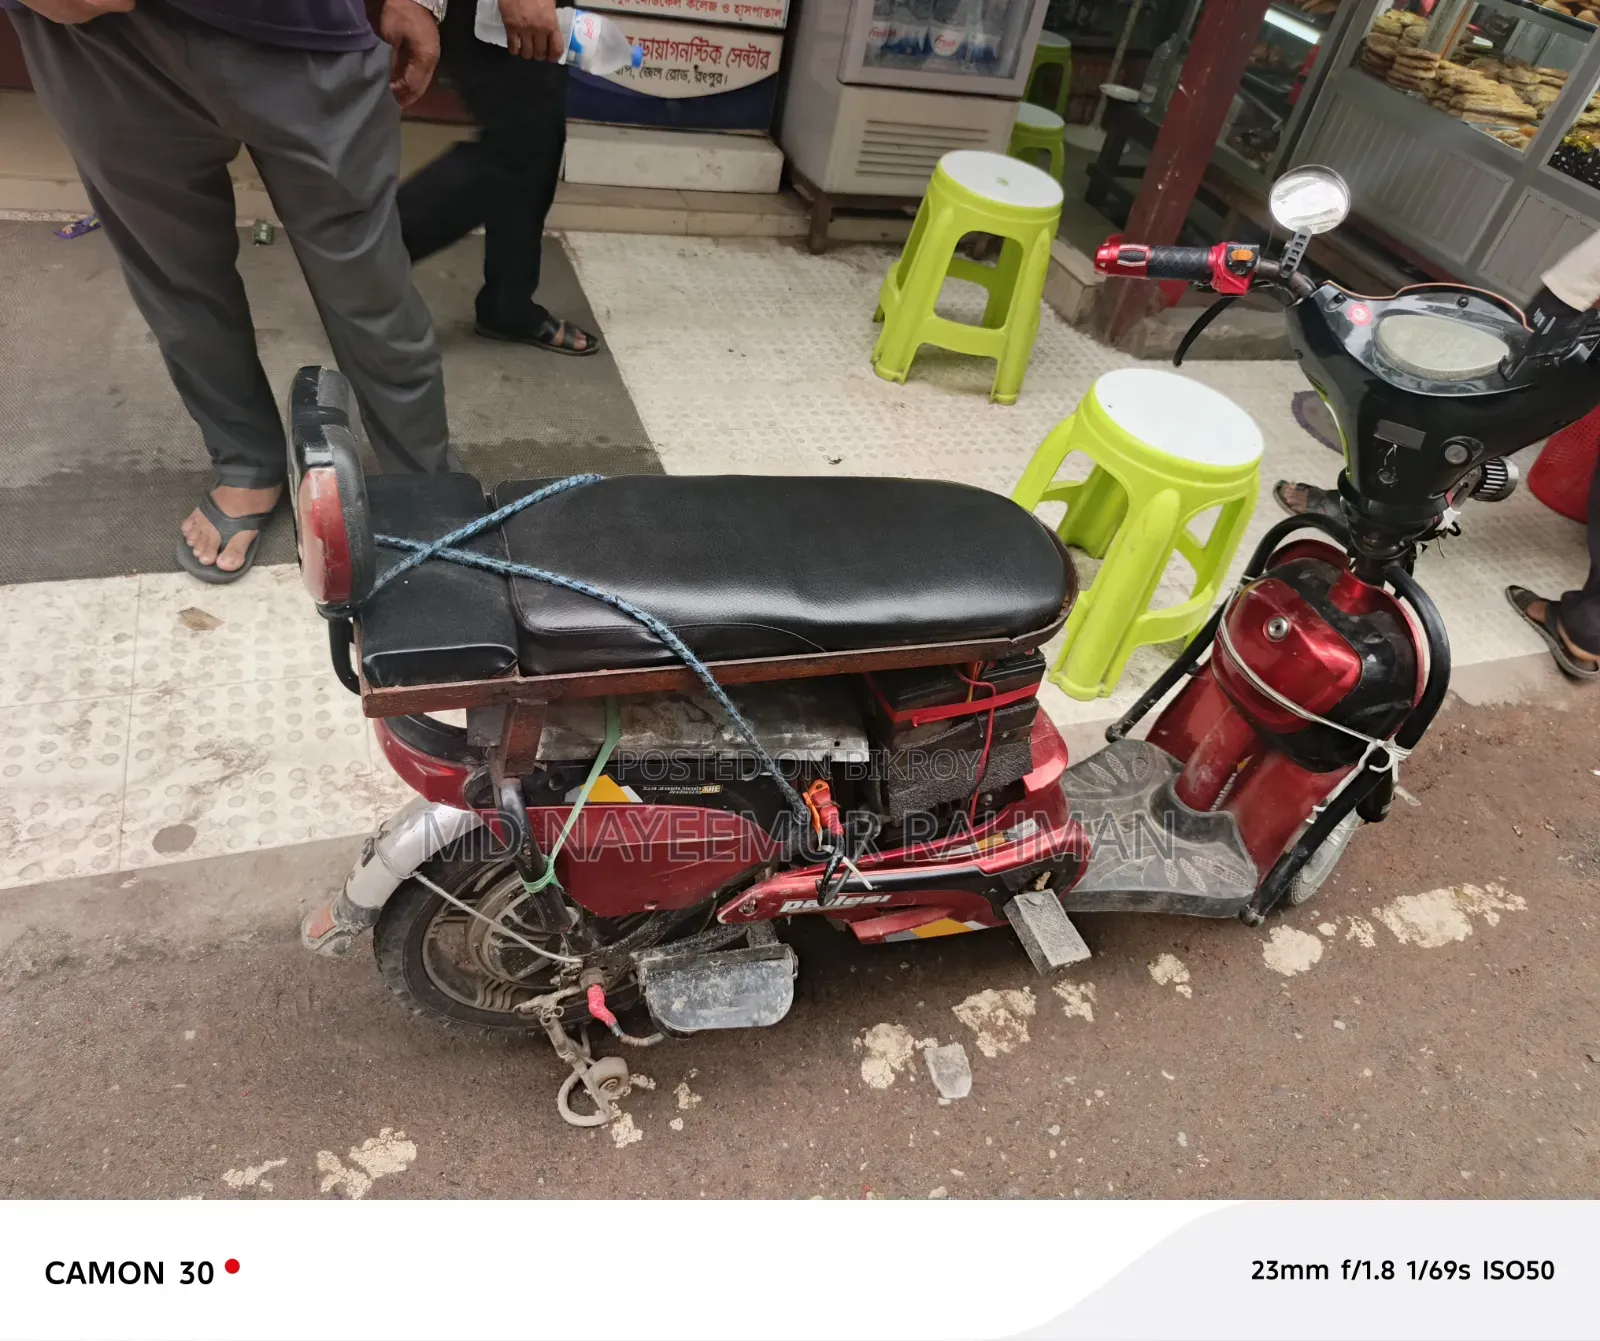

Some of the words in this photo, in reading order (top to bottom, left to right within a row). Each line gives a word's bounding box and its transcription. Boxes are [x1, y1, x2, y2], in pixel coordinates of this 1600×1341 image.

[722, 4, 730, 14] ও
[734, 5, 783, 20] হাসপাতাল
[726, 42, 772, 71] সেন্টার
